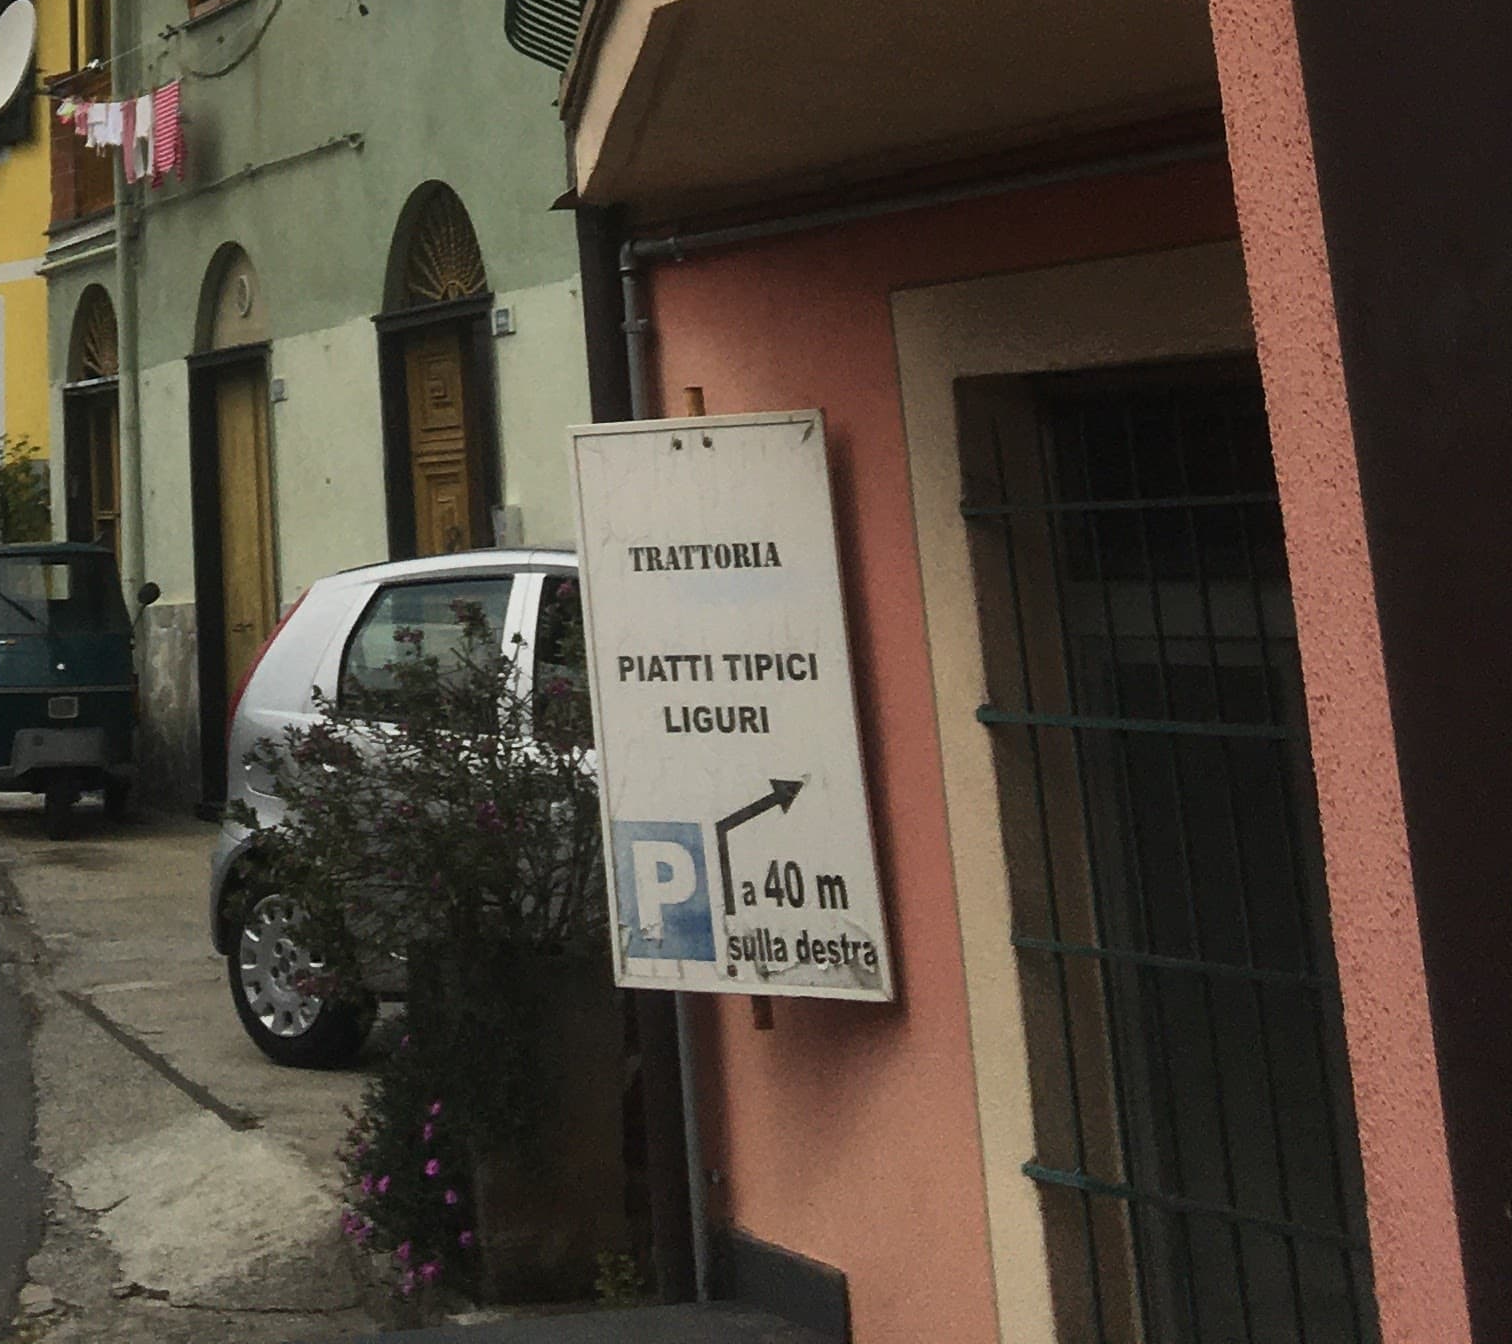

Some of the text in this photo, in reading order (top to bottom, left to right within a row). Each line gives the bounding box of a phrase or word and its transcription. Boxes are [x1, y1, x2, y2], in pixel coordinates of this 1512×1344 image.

[628, 540, 782, 574] TRATTORIA
[618, 652, 818, 683] PIATTI TIPICI
[665, 705, 770, 735] LIGURI
[632, 839, 697, 941] P
[743, 859, 849, 911] a 40 m
[729, 926, 879, 968] sulla destra
